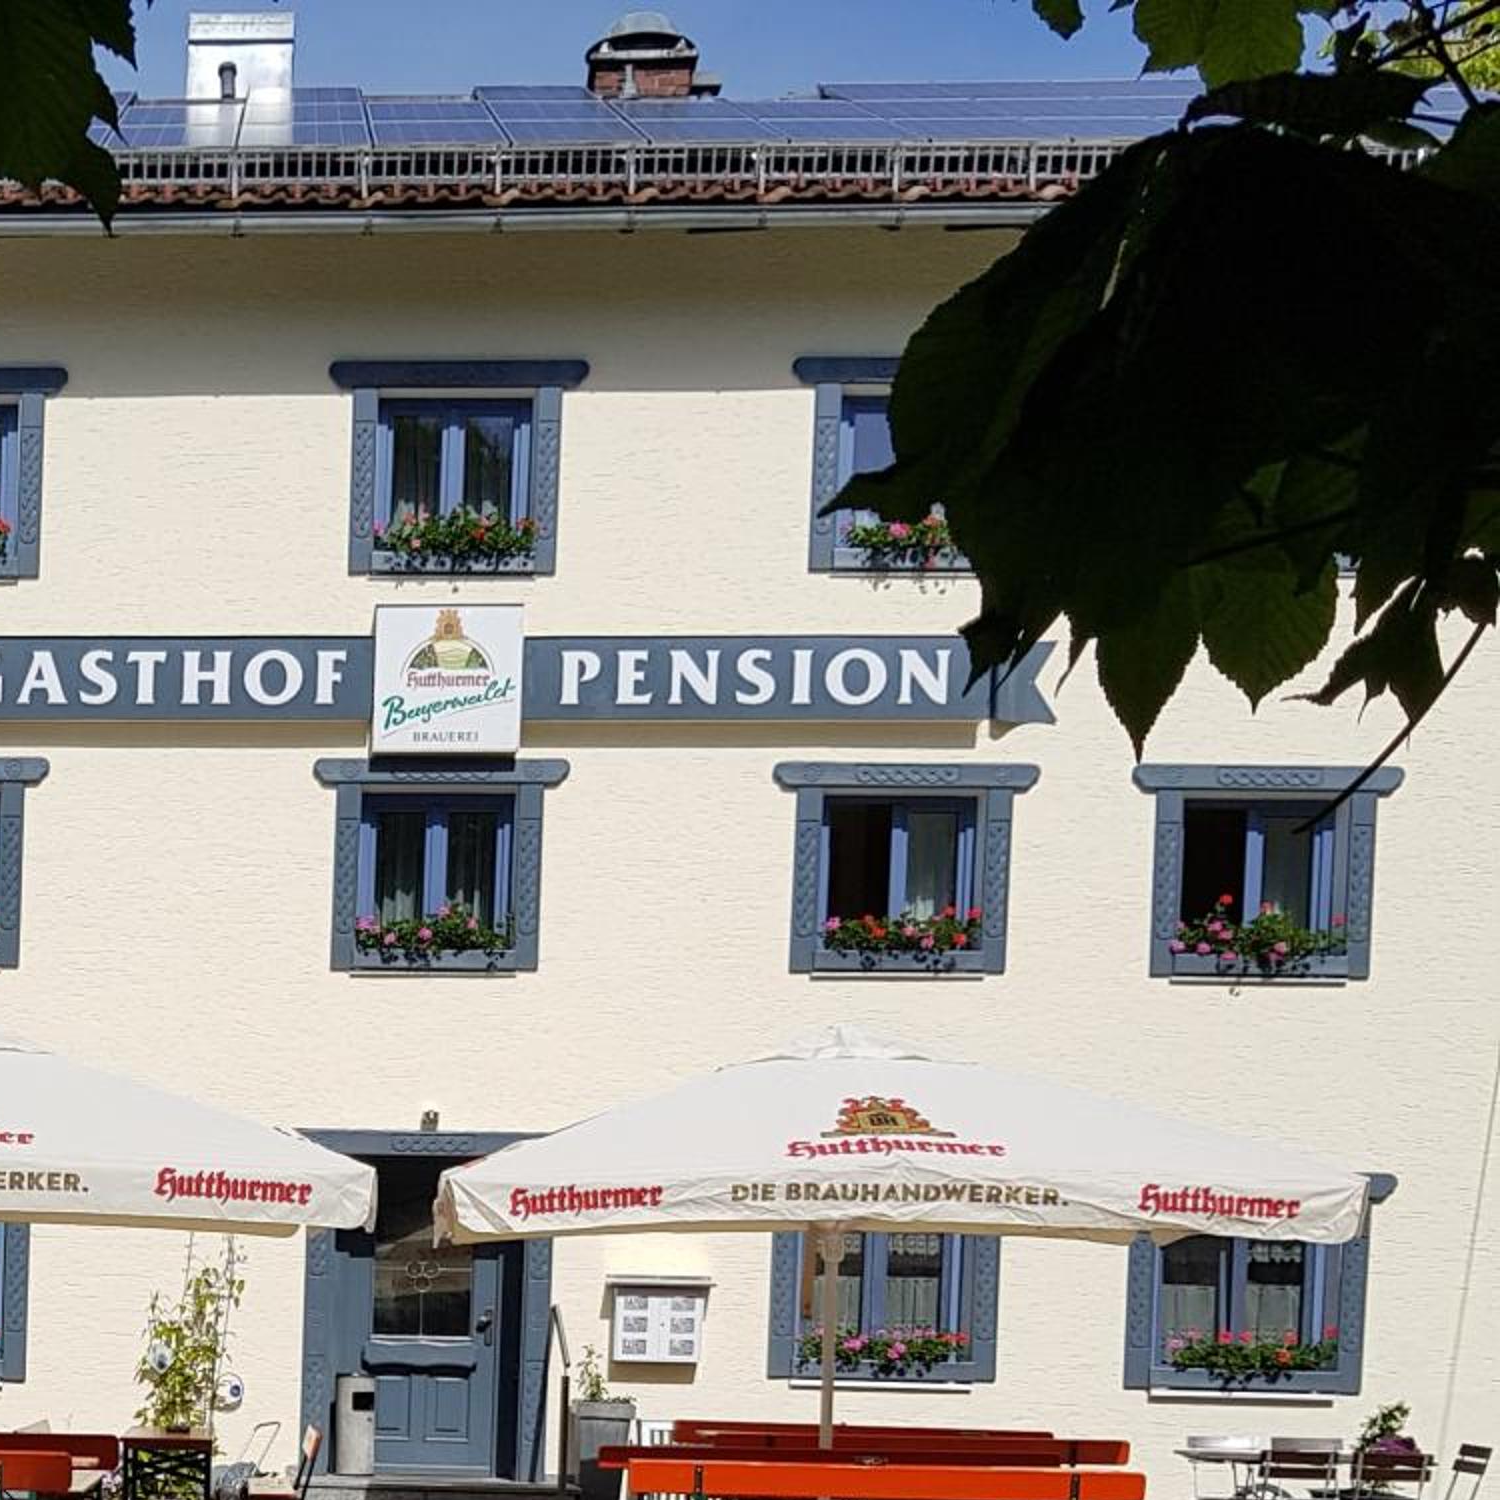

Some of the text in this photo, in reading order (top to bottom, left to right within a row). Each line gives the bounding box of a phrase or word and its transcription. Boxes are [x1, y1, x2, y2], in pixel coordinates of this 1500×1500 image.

[559, 648, 952, 705] PENSION
[412, 731, 479, 743] BRAUEREI
[784, 1136, 1008, 1160] Hutthurmer
[153, 1167, 313, 1206] Hutthurmer
[508, 1184, 664, 1221] Hutthurmer
[731, 1182, 1070, 1207] DIE BRAUHANDWERKER.
[1137, 1183, 1302, 1221] Hutthurmer
